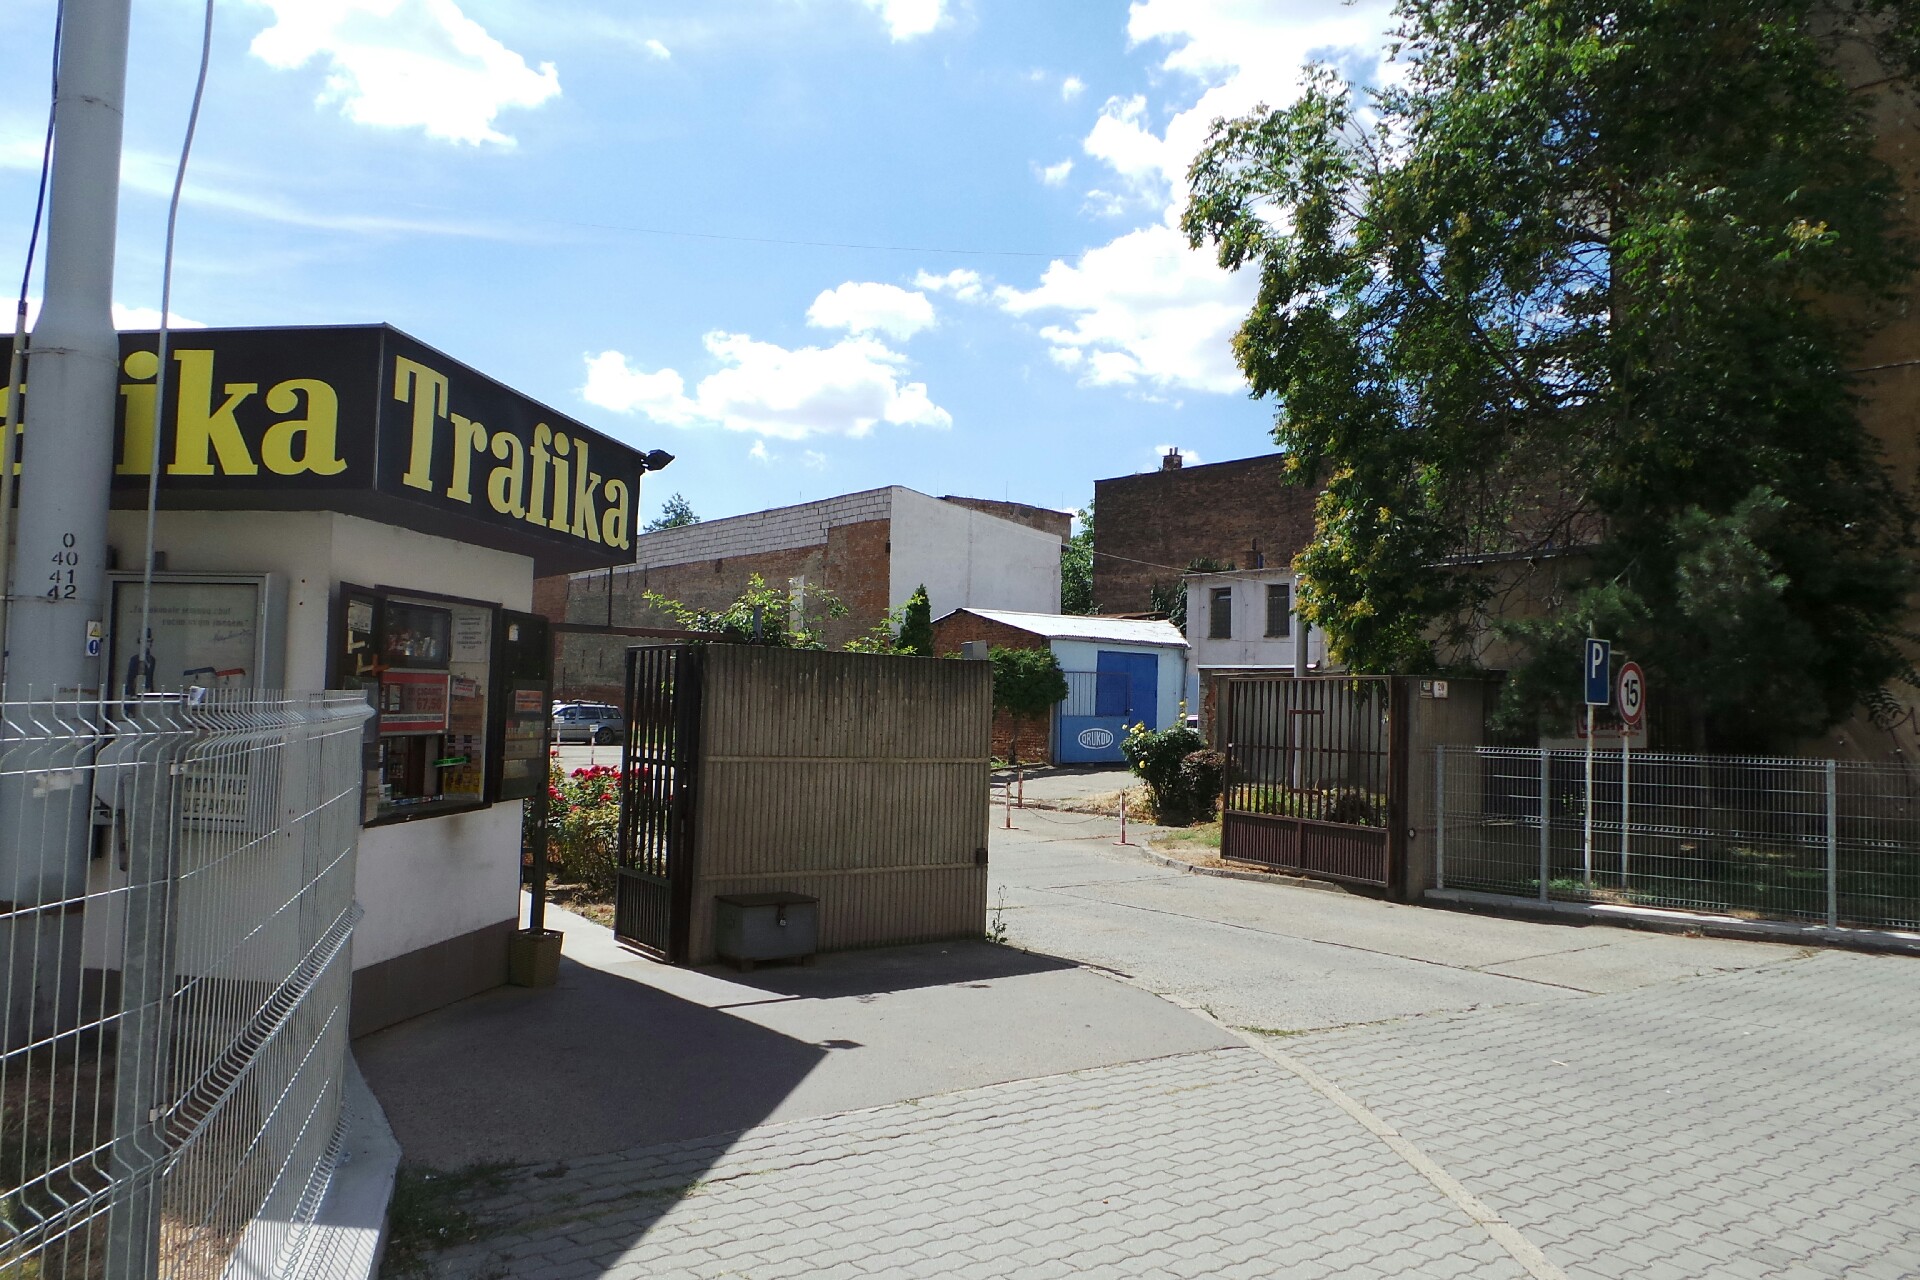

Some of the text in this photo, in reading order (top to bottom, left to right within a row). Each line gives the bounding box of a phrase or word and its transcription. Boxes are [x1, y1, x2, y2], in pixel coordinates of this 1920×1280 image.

[394, 354, 630, 551] Trafika
[51, 551, 78, 566] 40
[49, 569, 74, 584] 41
[47, 584, 76, 601] 42
[1591, 642, 1604, 679] P
[1624, 678, 1639, 707] 15
